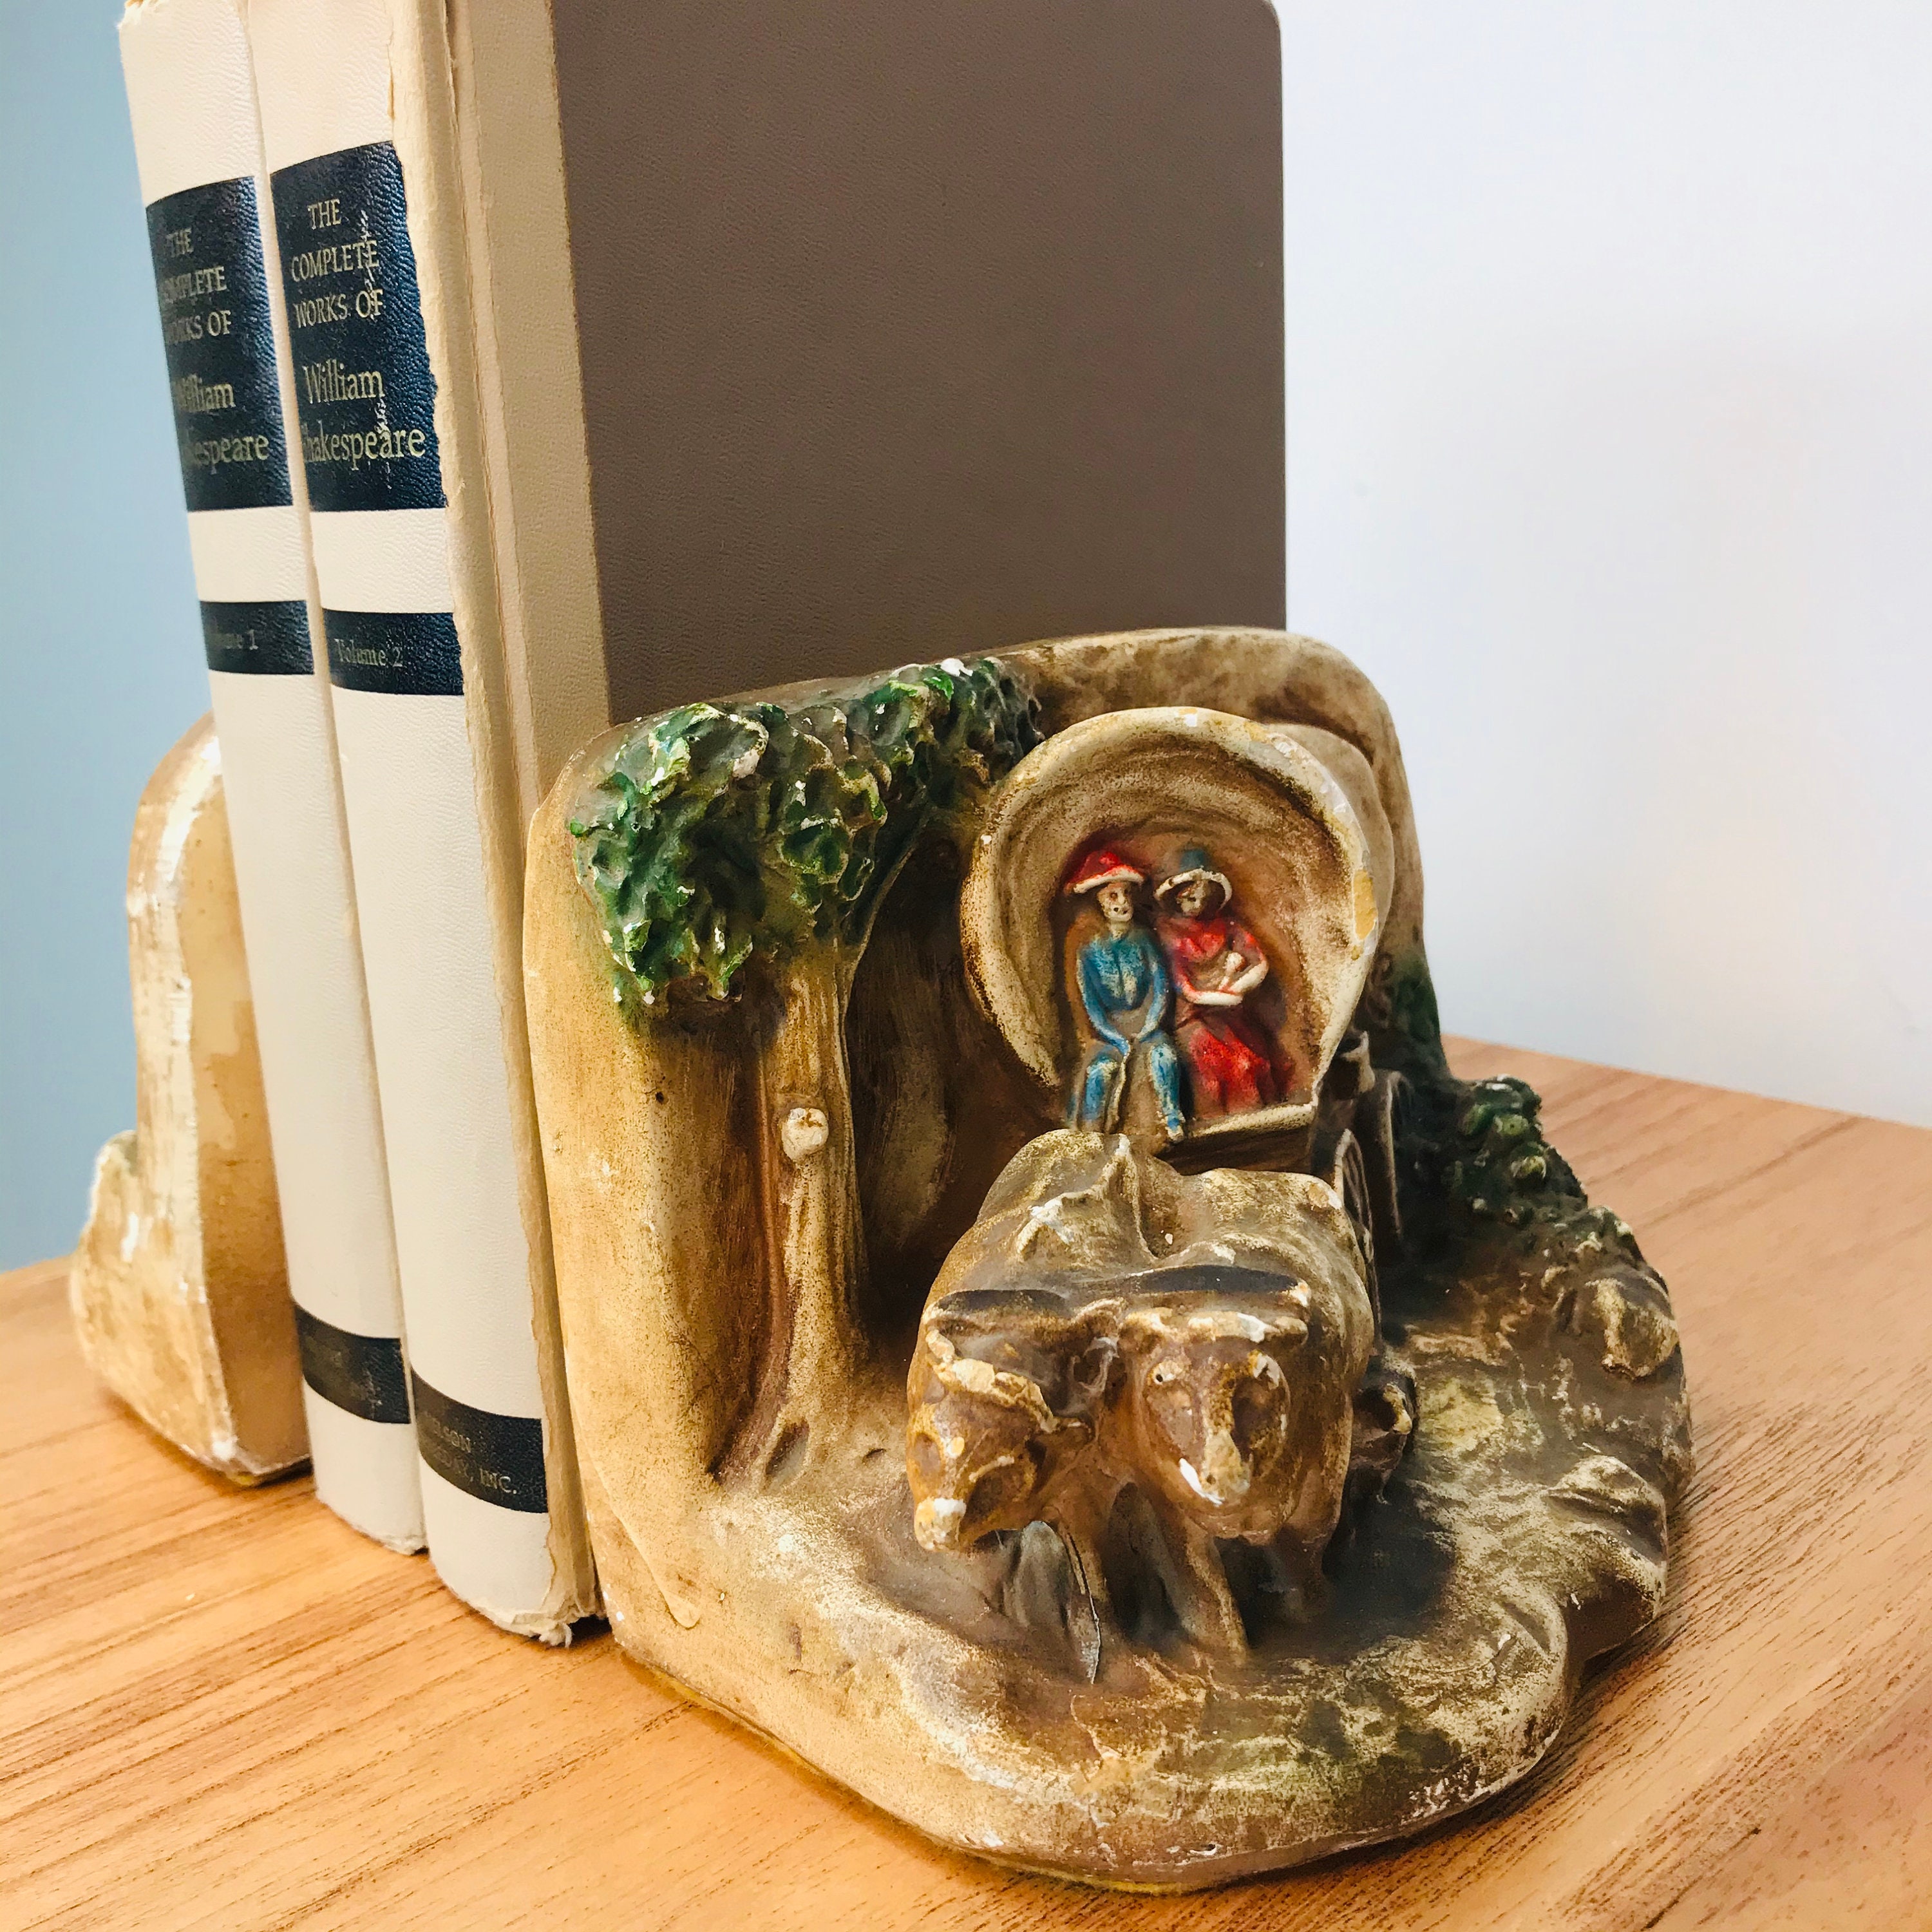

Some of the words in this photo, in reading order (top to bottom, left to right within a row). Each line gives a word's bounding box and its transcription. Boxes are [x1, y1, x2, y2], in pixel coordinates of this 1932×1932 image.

[306, 198, 342, 230] THE
[291, 239, 380, 283] COMPLETE
[207, 310, 232, 337] OF
[293, 293, 350, 328] WORKS
[355, 289, 384, 319] OF
[301, 358, 386, 404] William
[334, 638, 387, 667] Volume
[391, 645, 404, 668] 2
